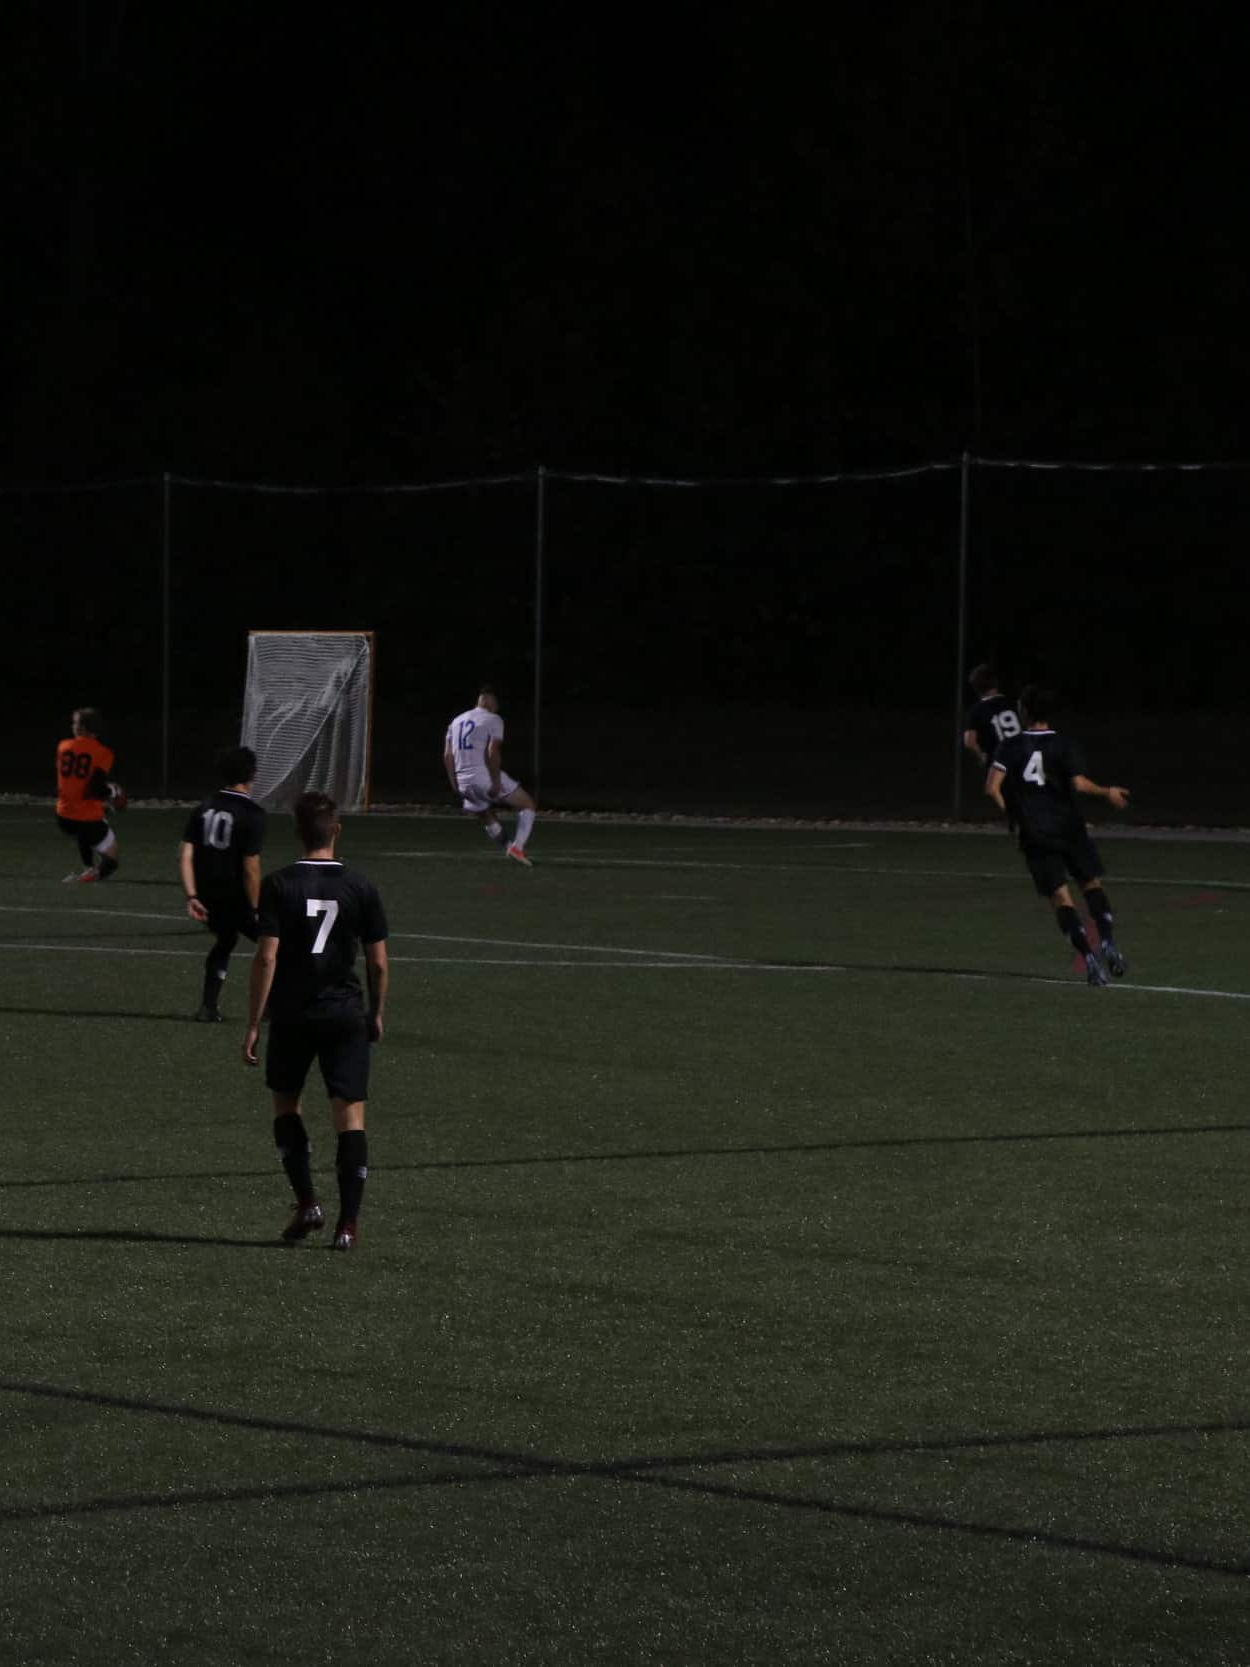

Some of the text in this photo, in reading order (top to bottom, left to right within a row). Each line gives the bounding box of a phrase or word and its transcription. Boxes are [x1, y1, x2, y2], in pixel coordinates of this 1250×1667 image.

[458, 720, 476, 750] 12
[990, 709, 1022, 742] 19
[1022, 750, 1047, 786] 4
[202, 811, 234, 850] 10
[306, 898, 339, 954] 7
